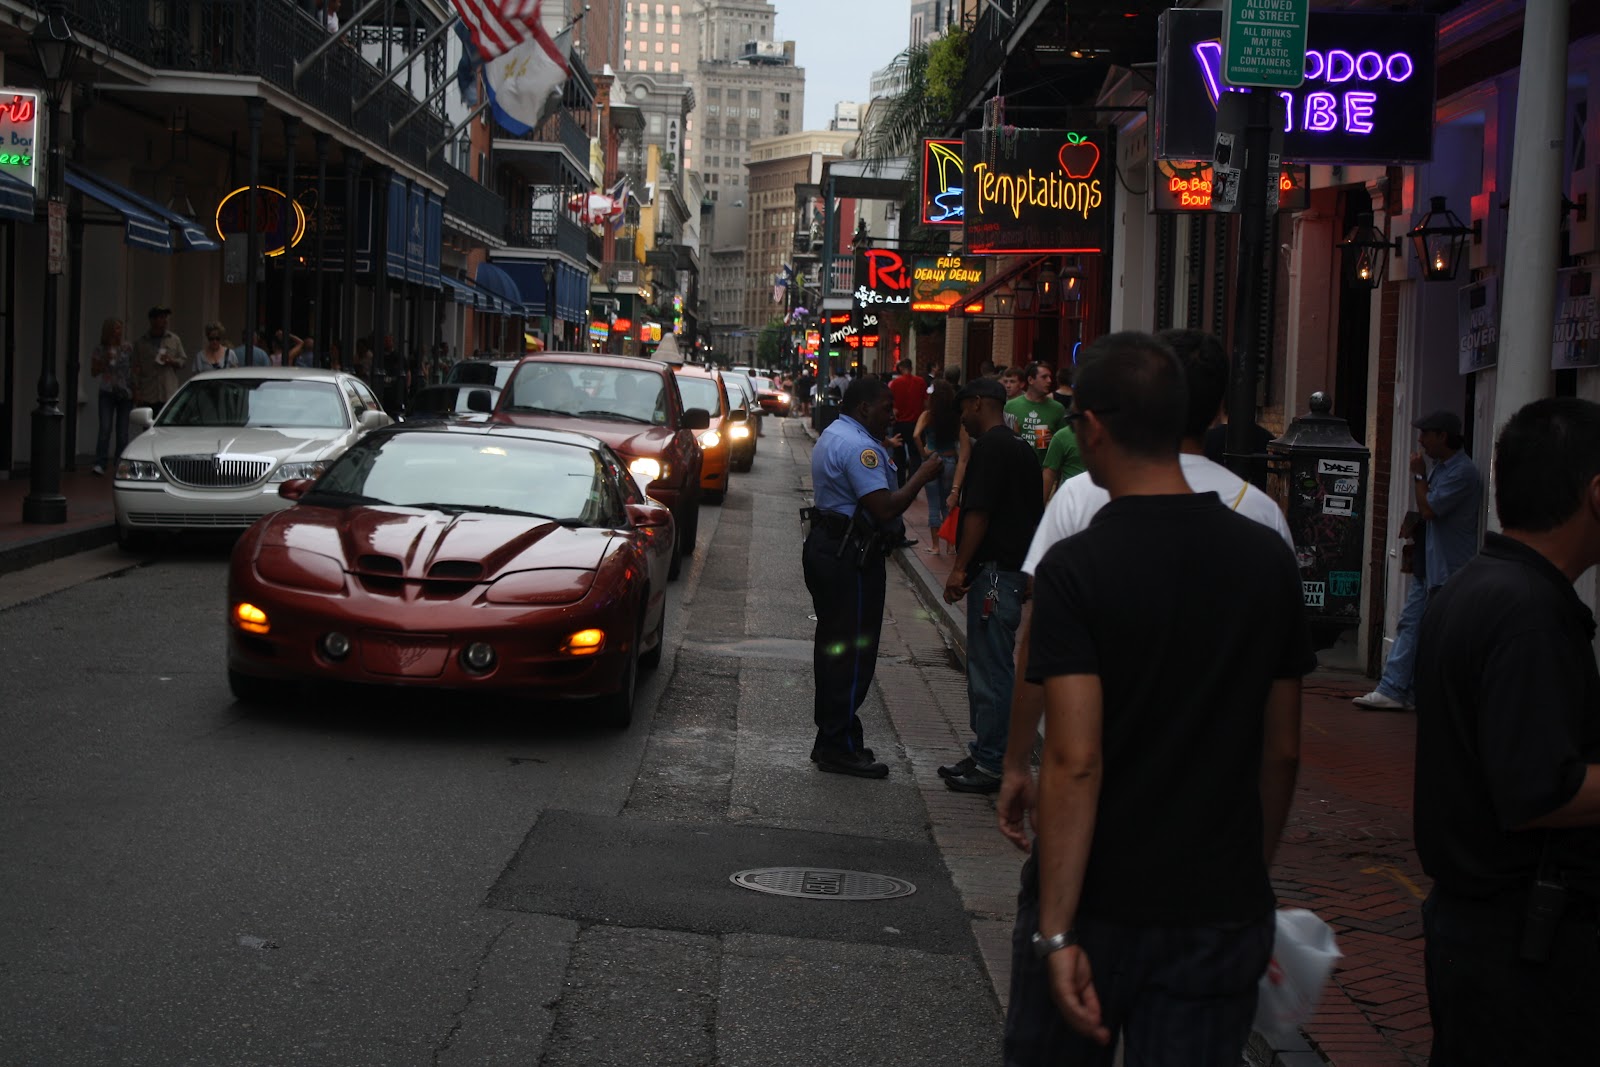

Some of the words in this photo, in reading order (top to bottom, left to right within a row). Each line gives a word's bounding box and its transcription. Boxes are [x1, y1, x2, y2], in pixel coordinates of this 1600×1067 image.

[1246, 0, 1293, 10] ALLOWED
[1241, 9, 1255, 19] ON
[1259, 10, 1296, 22] STREET
[1243, 27, 1258, 36] ALL
[1261, 28, 1292, 38] DRINKS
[1251, 37, 1269, 46] MAY
[1271, 39, 1283, 47] BE
[1243, 47, 1253, 55] IN
[1256, 47, 1289, 57] PLASTIC
[1240, 56, 1291, 67] CONTAINERS
[11, 131, 33, 146] Bar
[973, 161, 1102, 219] Temptations
[1170, 177, 1188, 191] Da
[1190, 177, 1212, 192] Bay
[1181, 191, 1211, 206] Bour
[937, 257, 961, 268] FAIS
[914, 268, 947, 281] DEAUX
[948, 268, 982, 283] DEAUX
[1560, 298, 1595, 319] LIVE
[1471, 311, 1485, 328] NO
[1553, 321, 1600, 342] MUSIC
[1460, 327, 1496, 352] COVER
